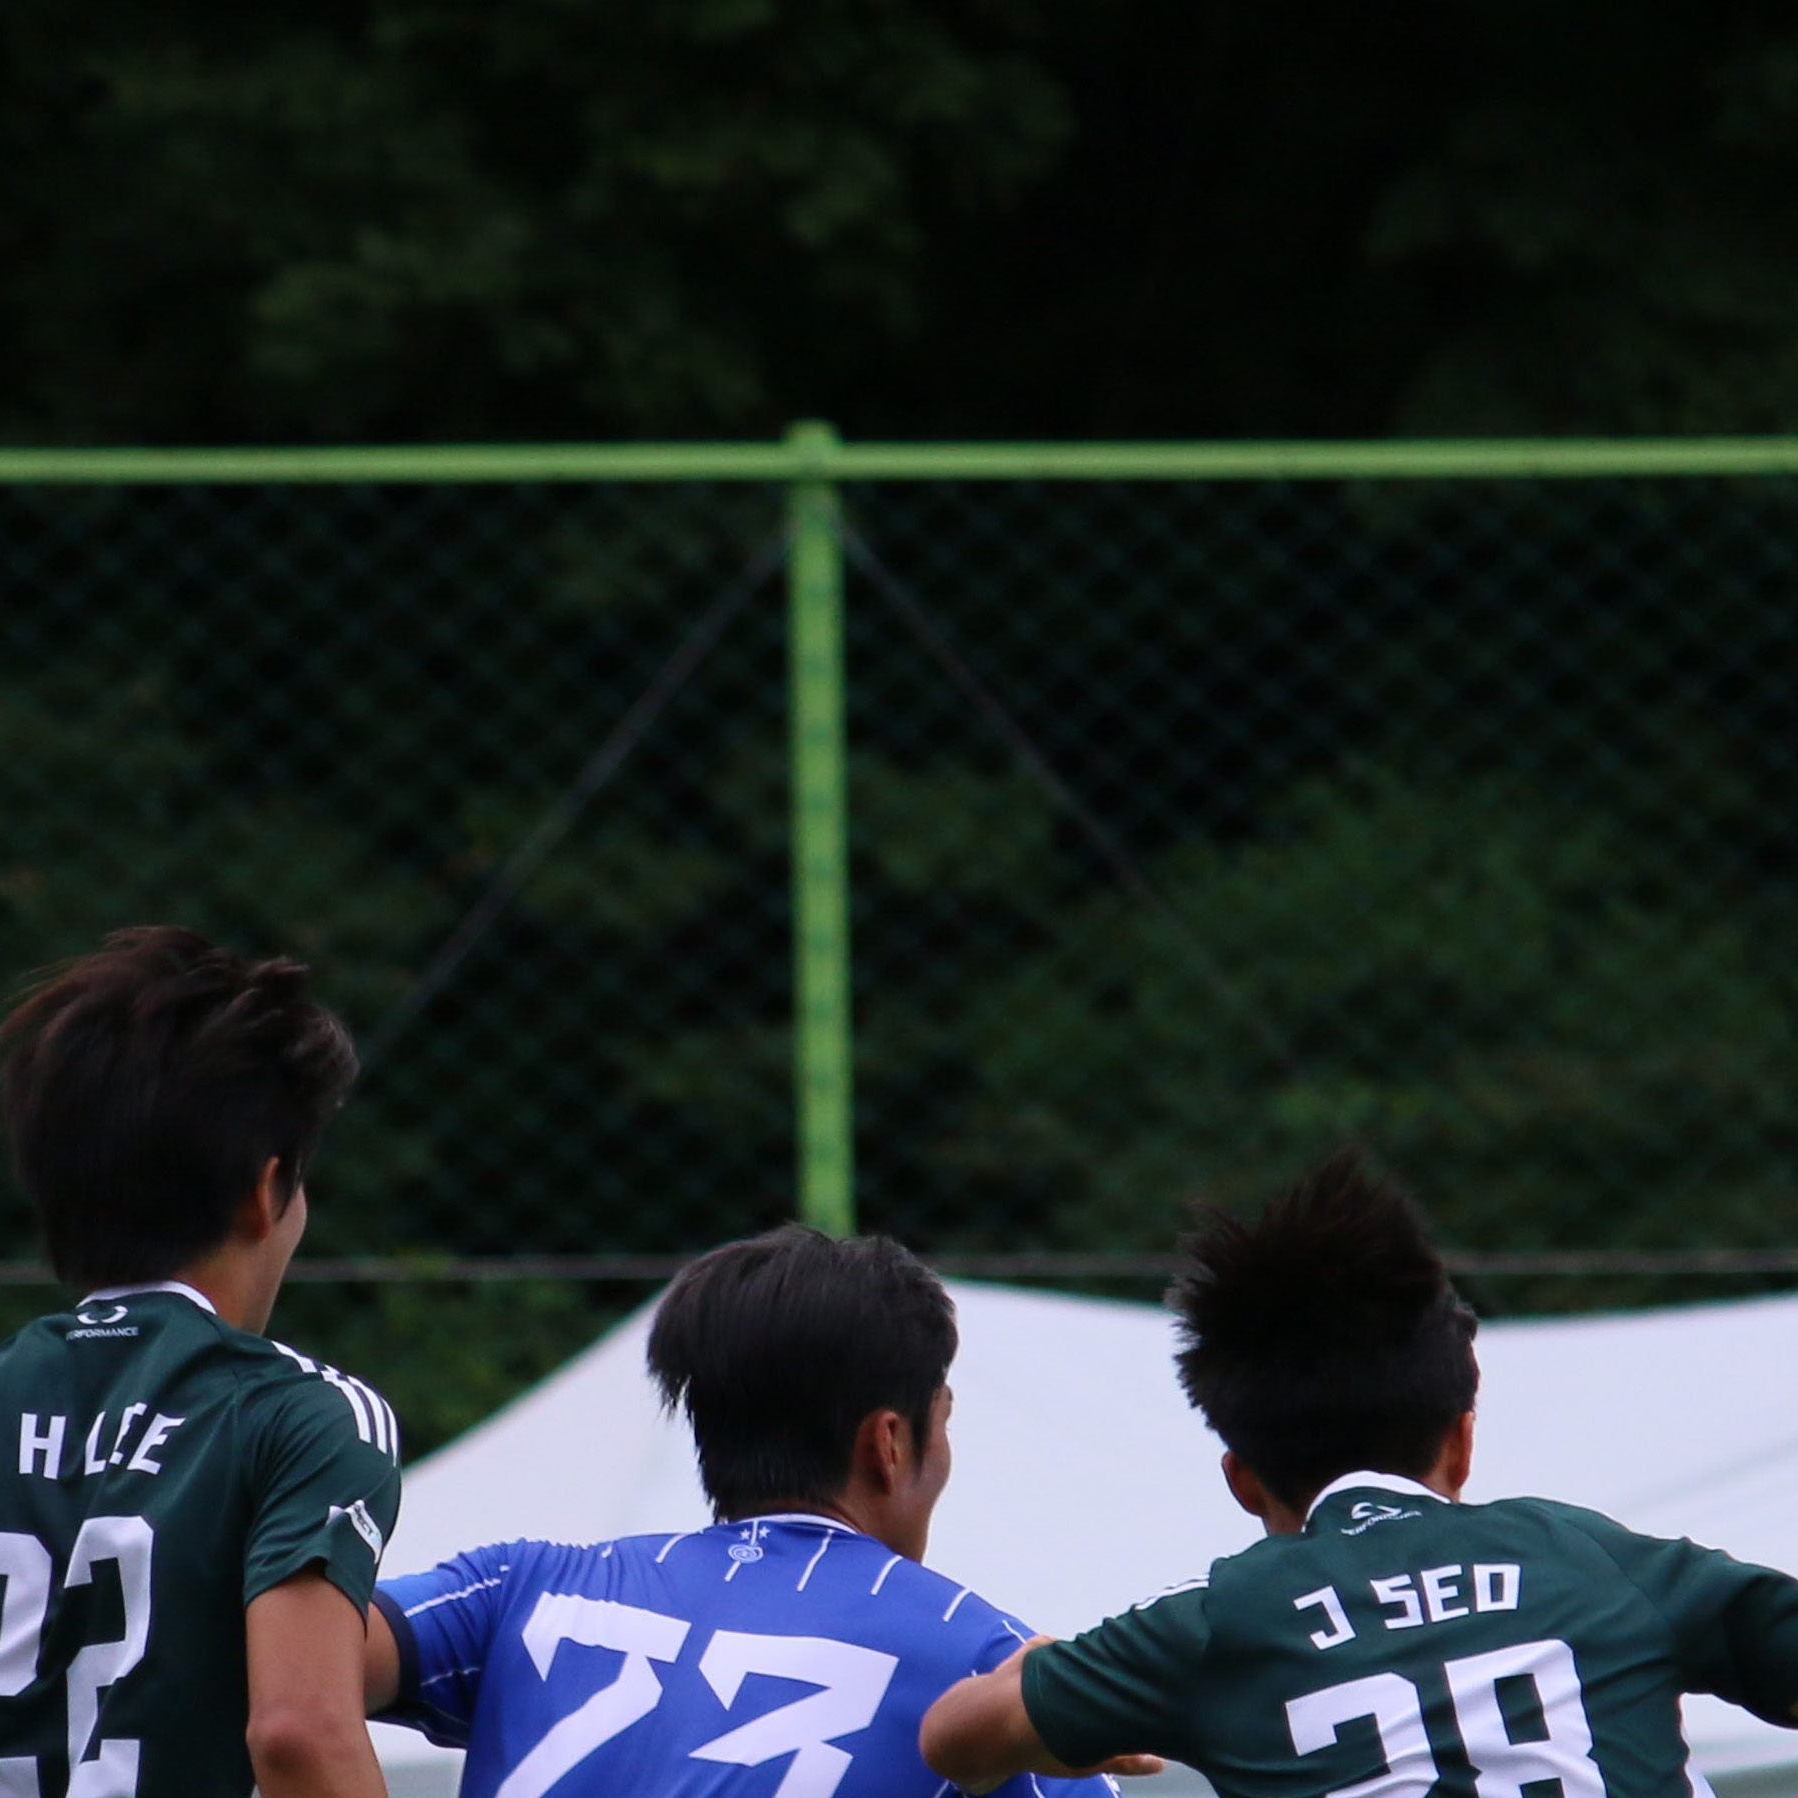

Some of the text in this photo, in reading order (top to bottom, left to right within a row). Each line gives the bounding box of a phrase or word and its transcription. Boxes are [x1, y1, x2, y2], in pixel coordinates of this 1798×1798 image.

[18, 1412, 67, 1480] H
[84, 1402, 187, 1476] LEE
[1293, 1585, 1356, 1651] J
